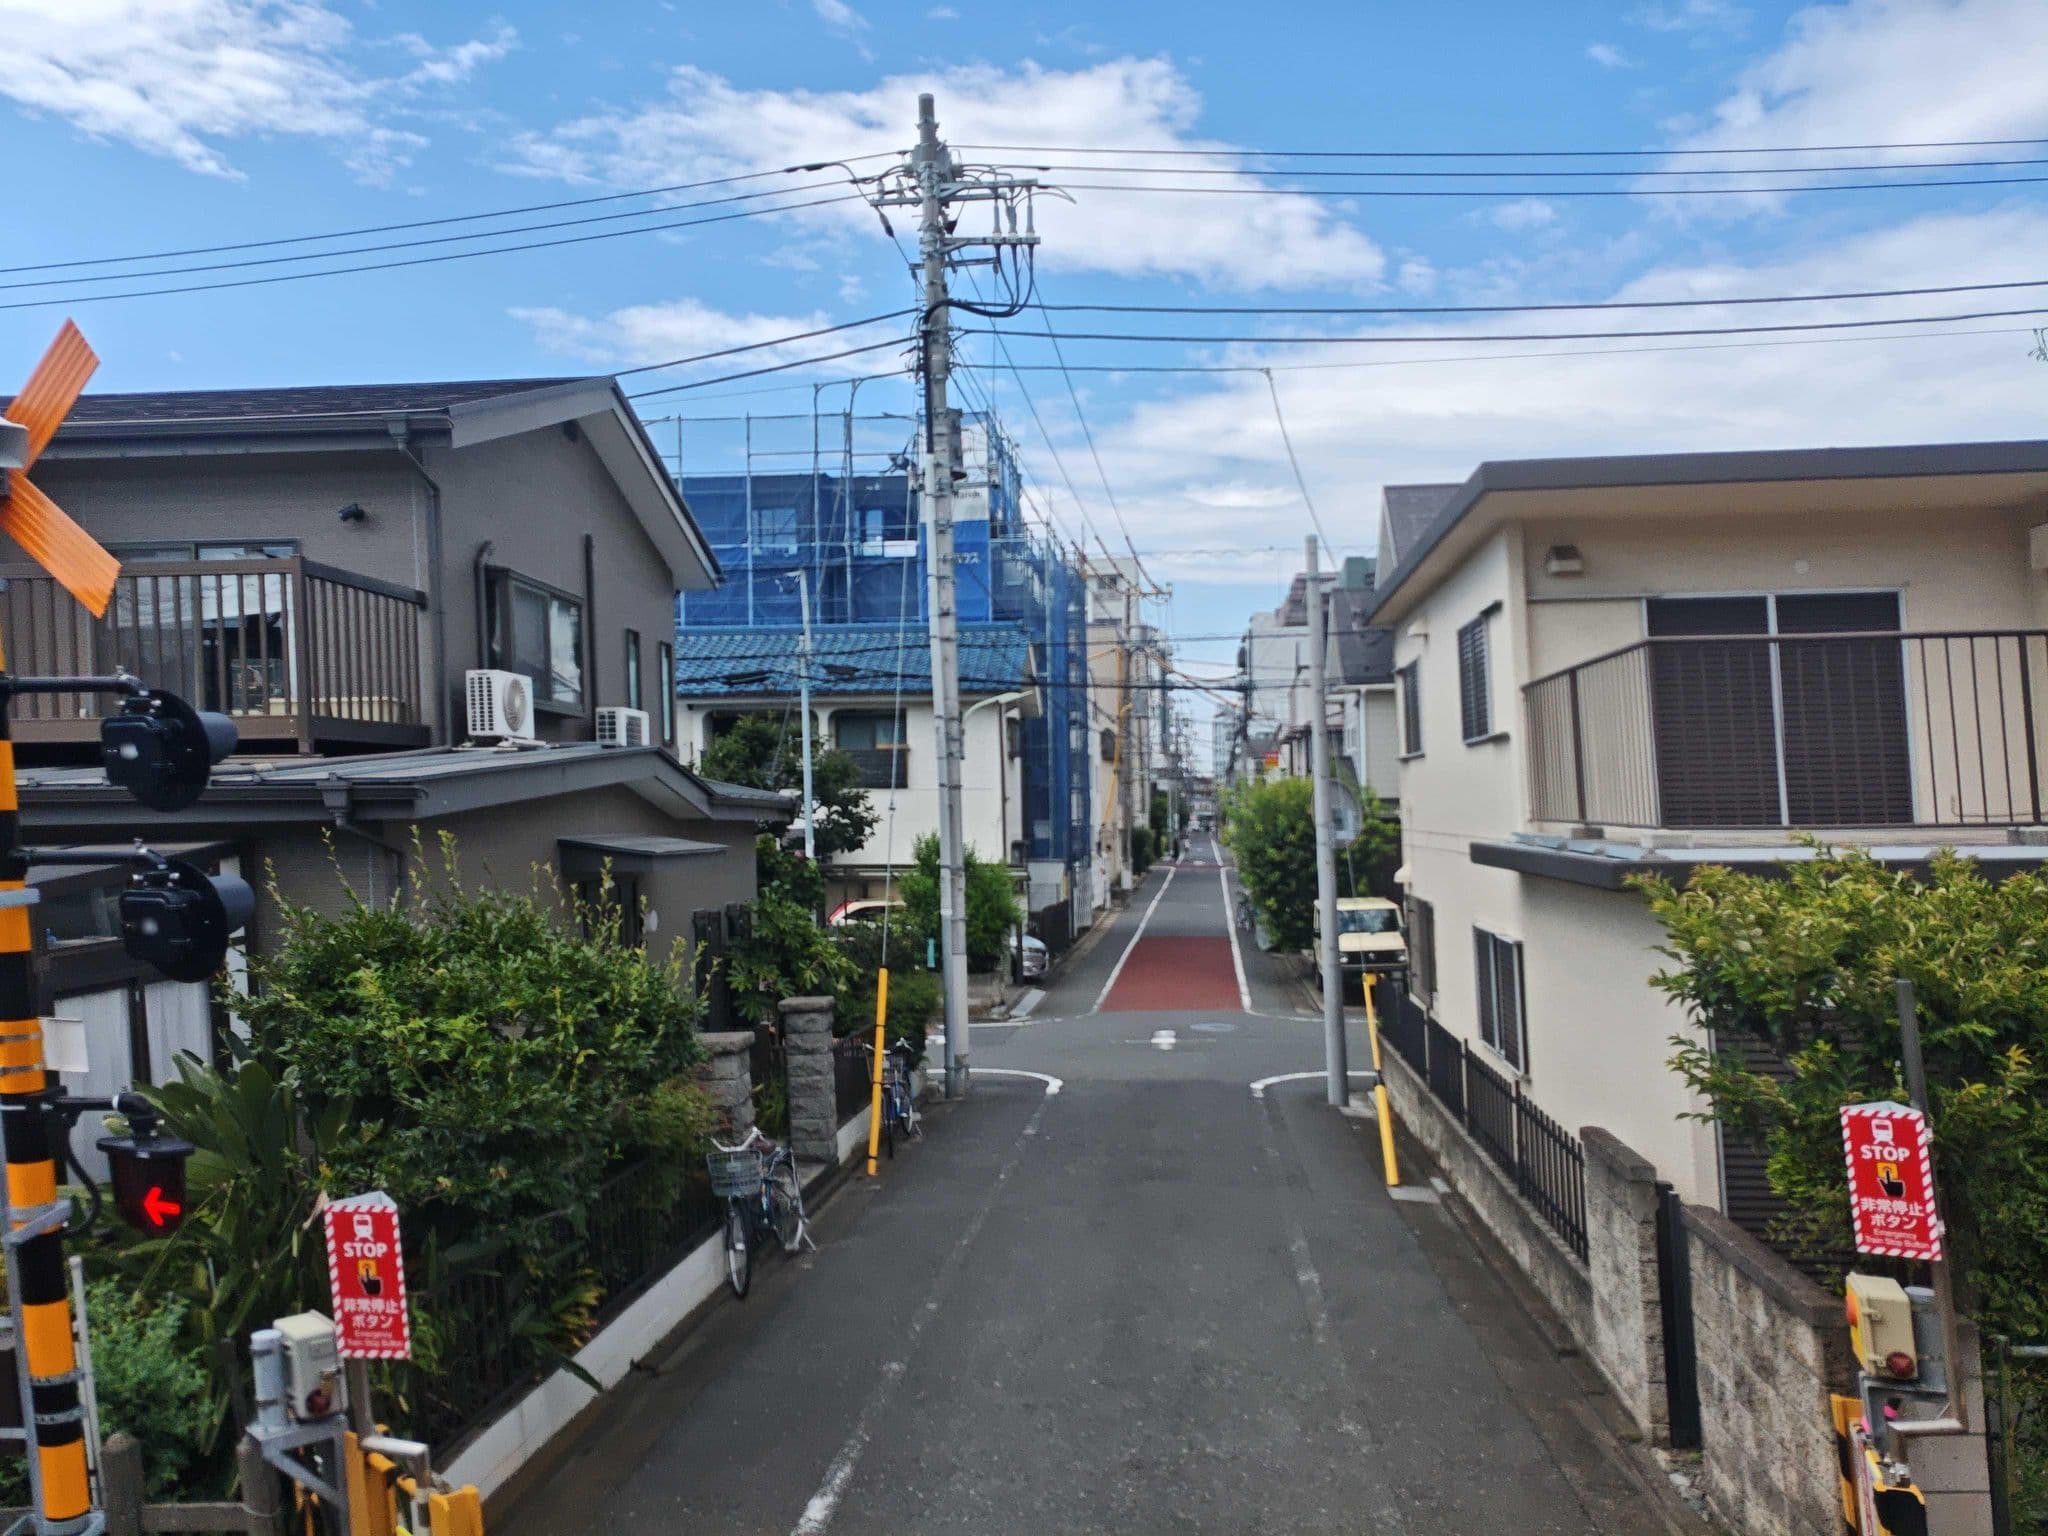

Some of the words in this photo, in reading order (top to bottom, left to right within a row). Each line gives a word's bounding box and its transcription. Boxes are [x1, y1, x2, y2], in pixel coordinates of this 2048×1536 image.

[1860, 1144, 1910, 1162] STOP
[1860, 1197, 1925, 1217] 非常停止
[1871, 1213, 1918, 1230] ボタン
[343, 1242, 388, 1258] STOP
[343, 1297, 400, 1314] 非常停止
[352, 1314, 394, 1329] ボタン
